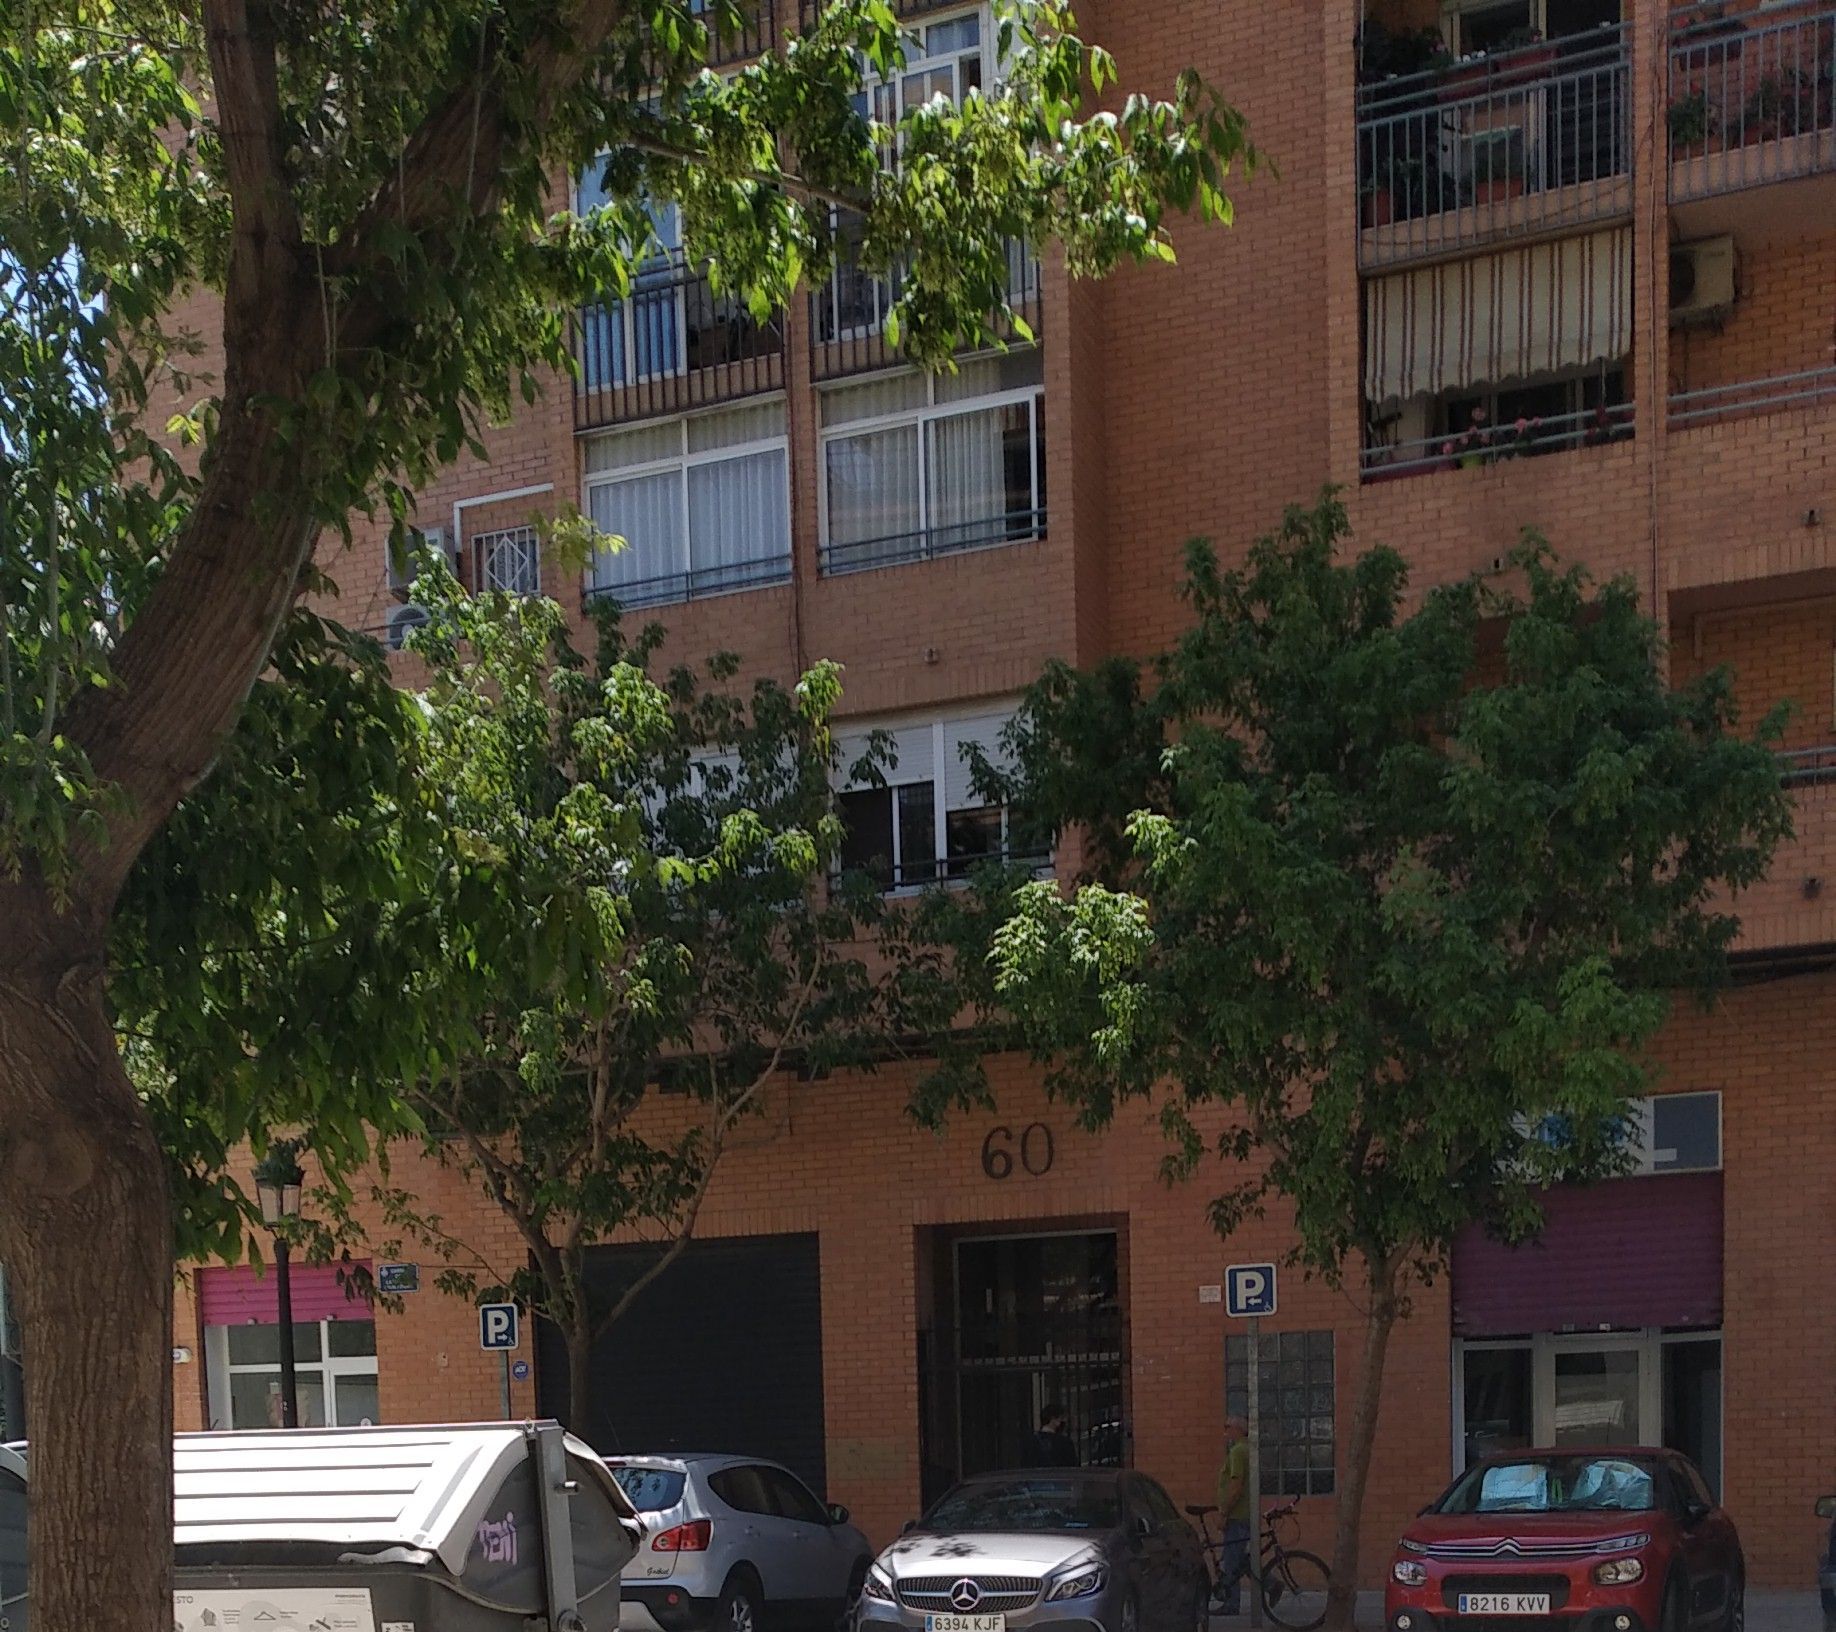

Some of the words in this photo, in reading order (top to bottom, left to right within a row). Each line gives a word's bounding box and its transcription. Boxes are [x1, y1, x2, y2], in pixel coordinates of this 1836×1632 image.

[981, 1122, 1054, 1180] 60
[1236, 1271, 1265, 1310] P
[487, 1310, 509, 1344] P
[175, 1596, 193, 1604] STO
[1470, 1597, 1509, 1611] 8216
[1517, 1597, 1545, 1611] KVV
[935, 1617, 968, 1631] 6394
[974, 1617, 1000, 1631] KJF
